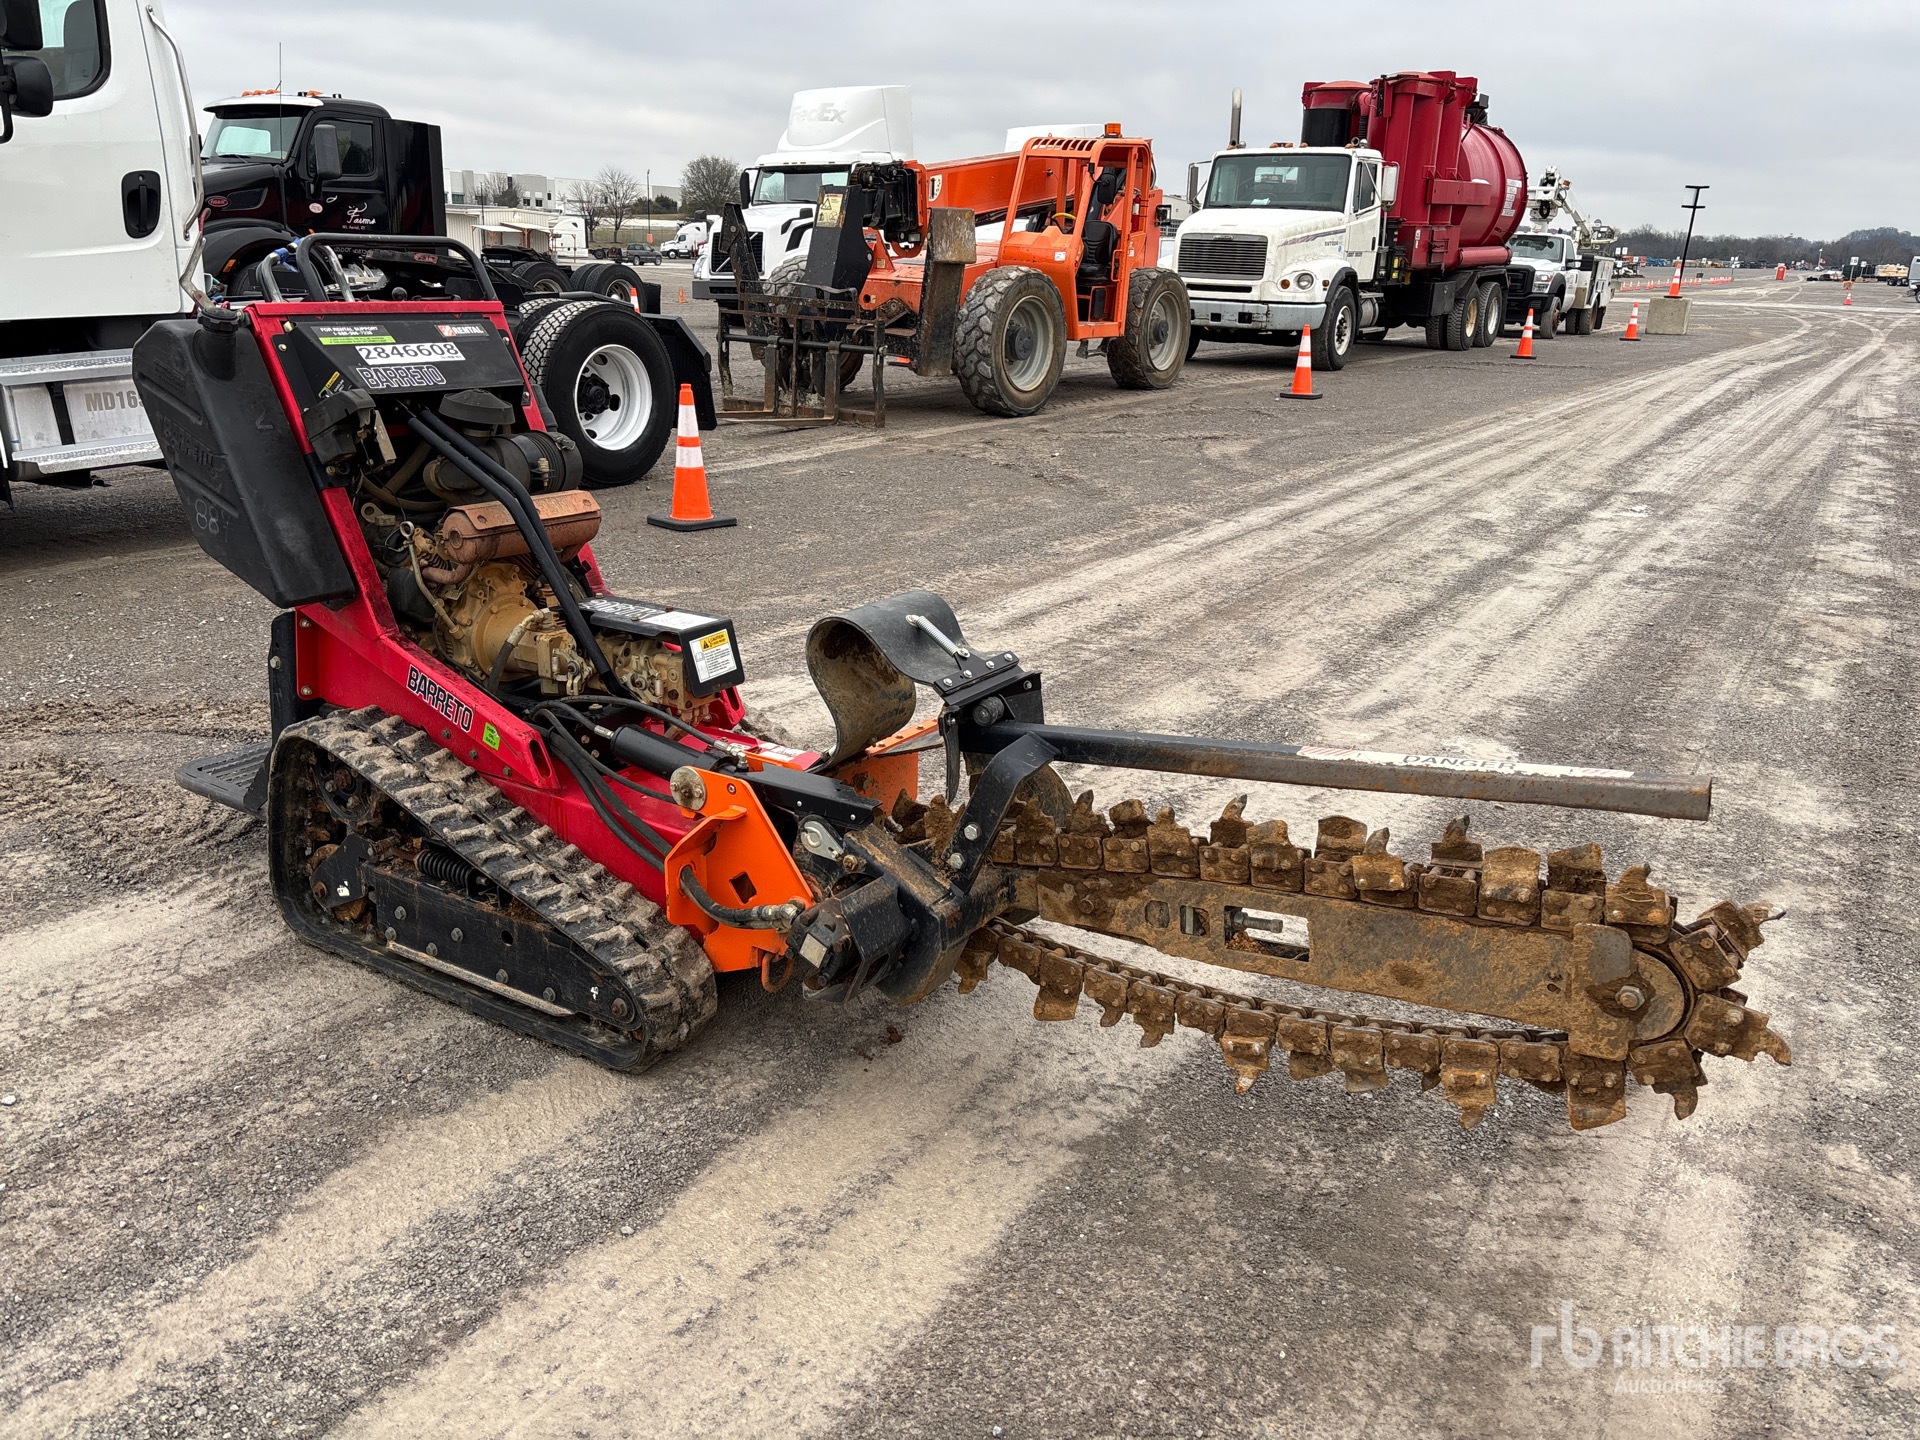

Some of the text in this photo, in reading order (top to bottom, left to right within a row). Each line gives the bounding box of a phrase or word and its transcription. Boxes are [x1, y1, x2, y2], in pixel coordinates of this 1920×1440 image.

[452, 326, 484, 334] RENTAL
[358, 344, 459, 360] 2846608
[356, 365, 446, 389] BARRETO
[406, 664, 474, 734] BARRETO
[1402, 755, 1517, 770] DANGER
